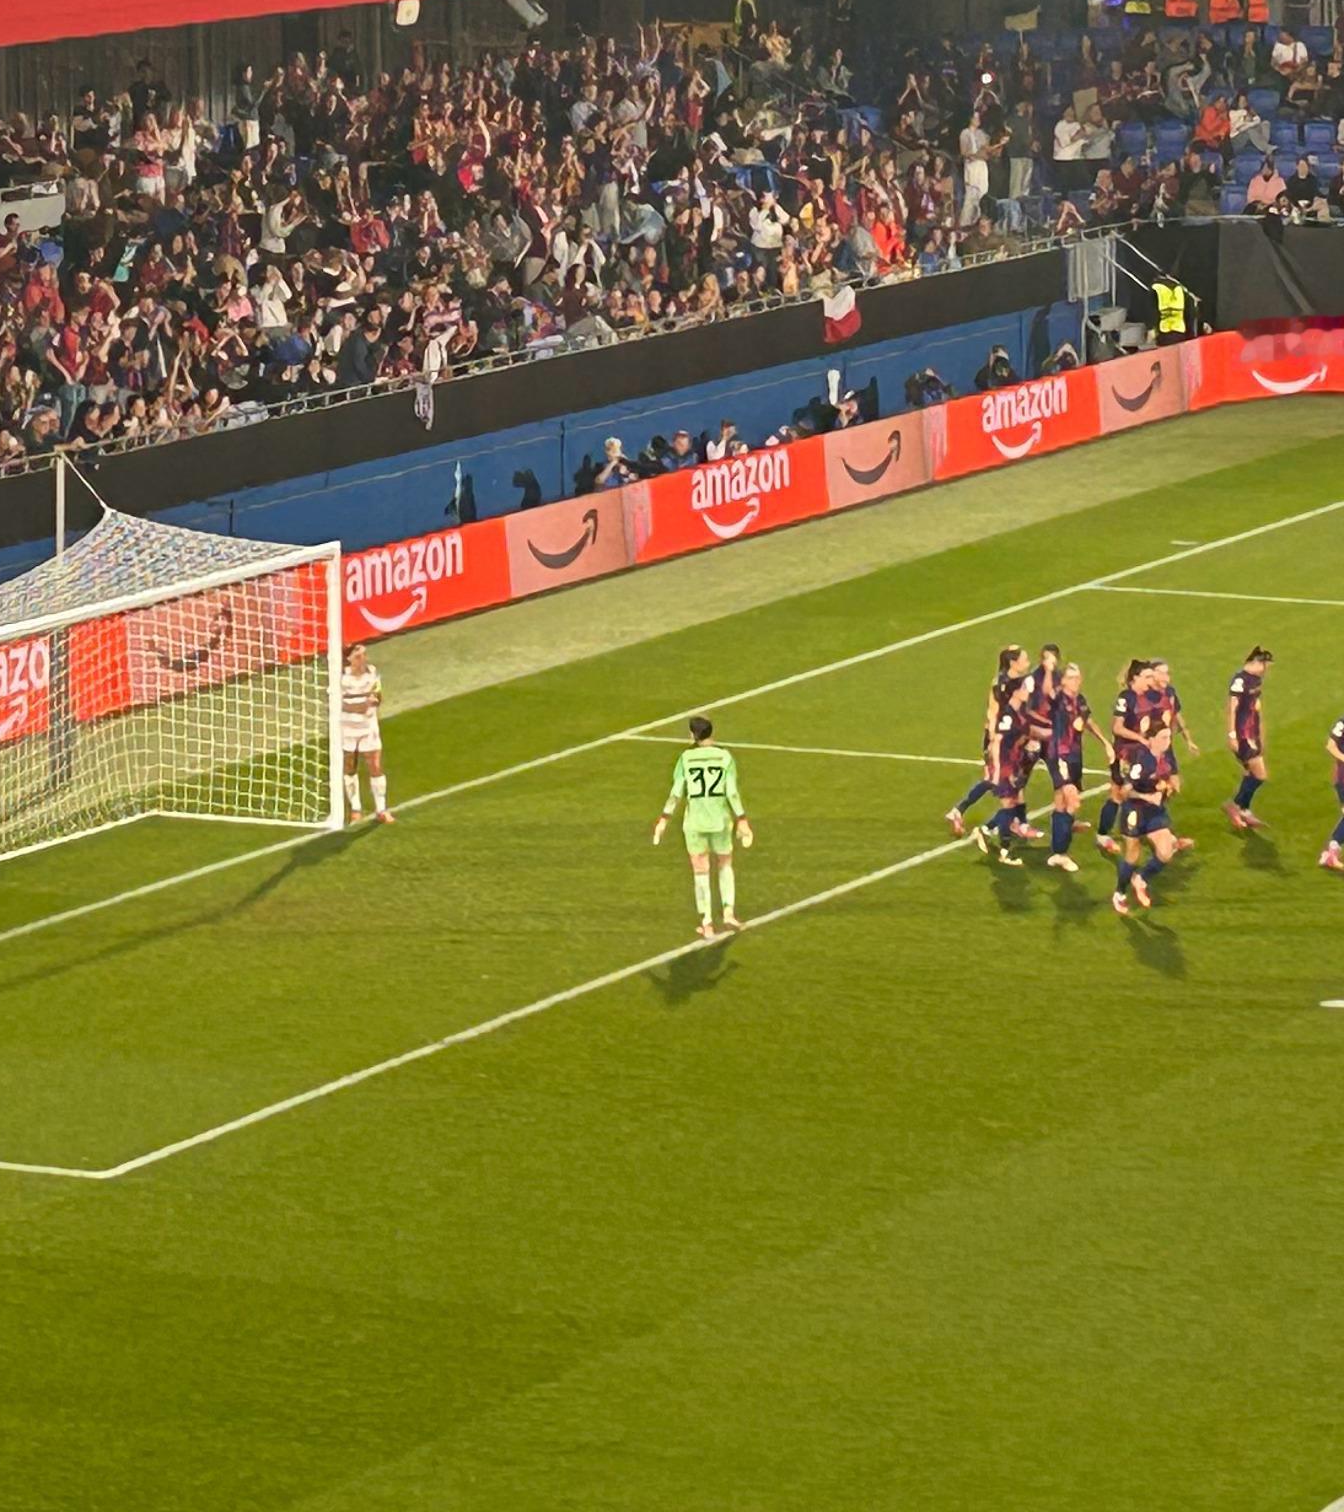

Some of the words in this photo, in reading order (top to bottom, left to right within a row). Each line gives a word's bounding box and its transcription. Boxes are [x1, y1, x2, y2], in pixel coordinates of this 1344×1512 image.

[982, 376, 1067, 433] amazon
[692, 450, 790, 510] amazon
[345, 530, 464, 603] amazon
[688, 766, 726, 798] 32
